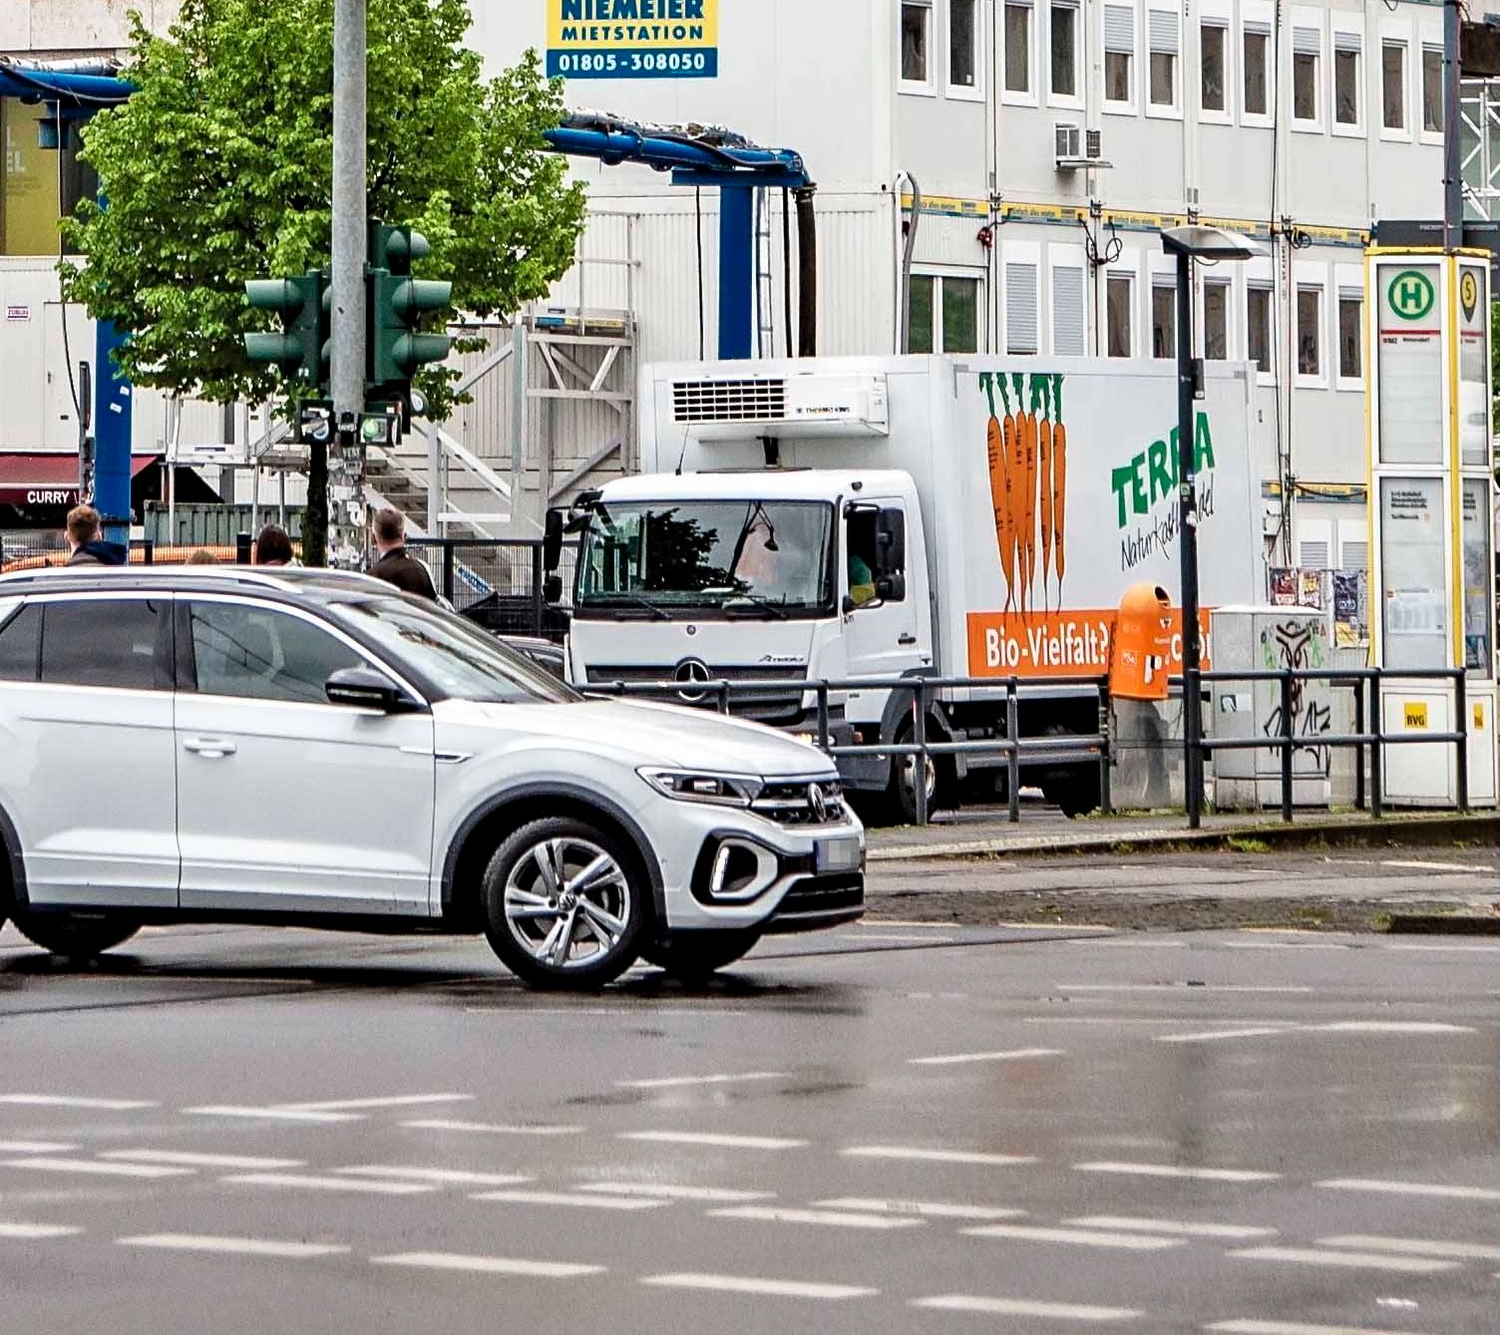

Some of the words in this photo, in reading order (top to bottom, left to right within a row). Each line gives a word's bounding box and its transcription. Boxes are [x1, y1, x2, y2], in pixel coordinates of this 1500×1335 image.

[561, 25, 703, 41] MIETSTATION
[27, 490, 70, 505] CURRY
[985, 621, 1110, 668] Bio-Vielfalt?
[1406, 714, 1425, 726] BVG
